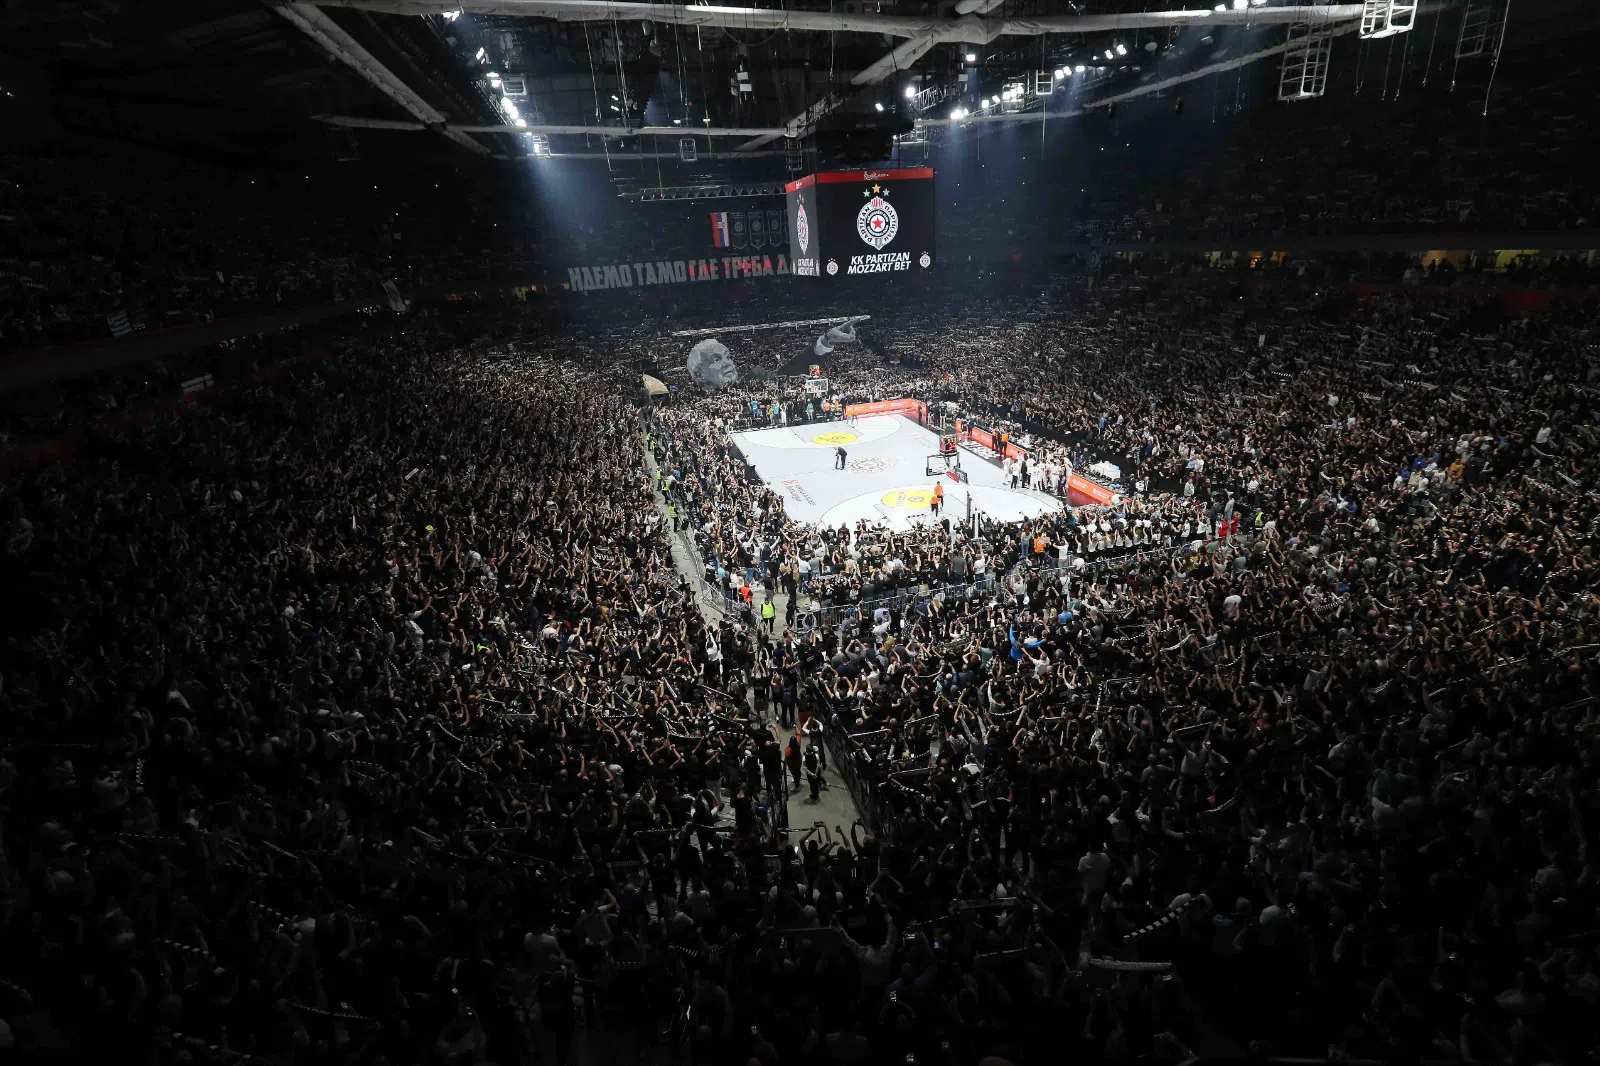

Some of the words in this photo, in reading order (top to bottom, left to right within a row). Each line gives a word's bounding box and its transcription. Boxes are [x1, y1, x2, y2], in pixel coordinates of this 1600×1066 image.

[850, 255, 865, 266] KK
[866, 252, 910, 263] PARTIZAN
[634, 261, 687, 285] ТАМО
[688, 258, 719, 282] ГДЕ
[722, 254, 774, 279] ТРЕБА
[847, 263, 892, 274] MOZZART
[894, 260, 912, 271] BET
